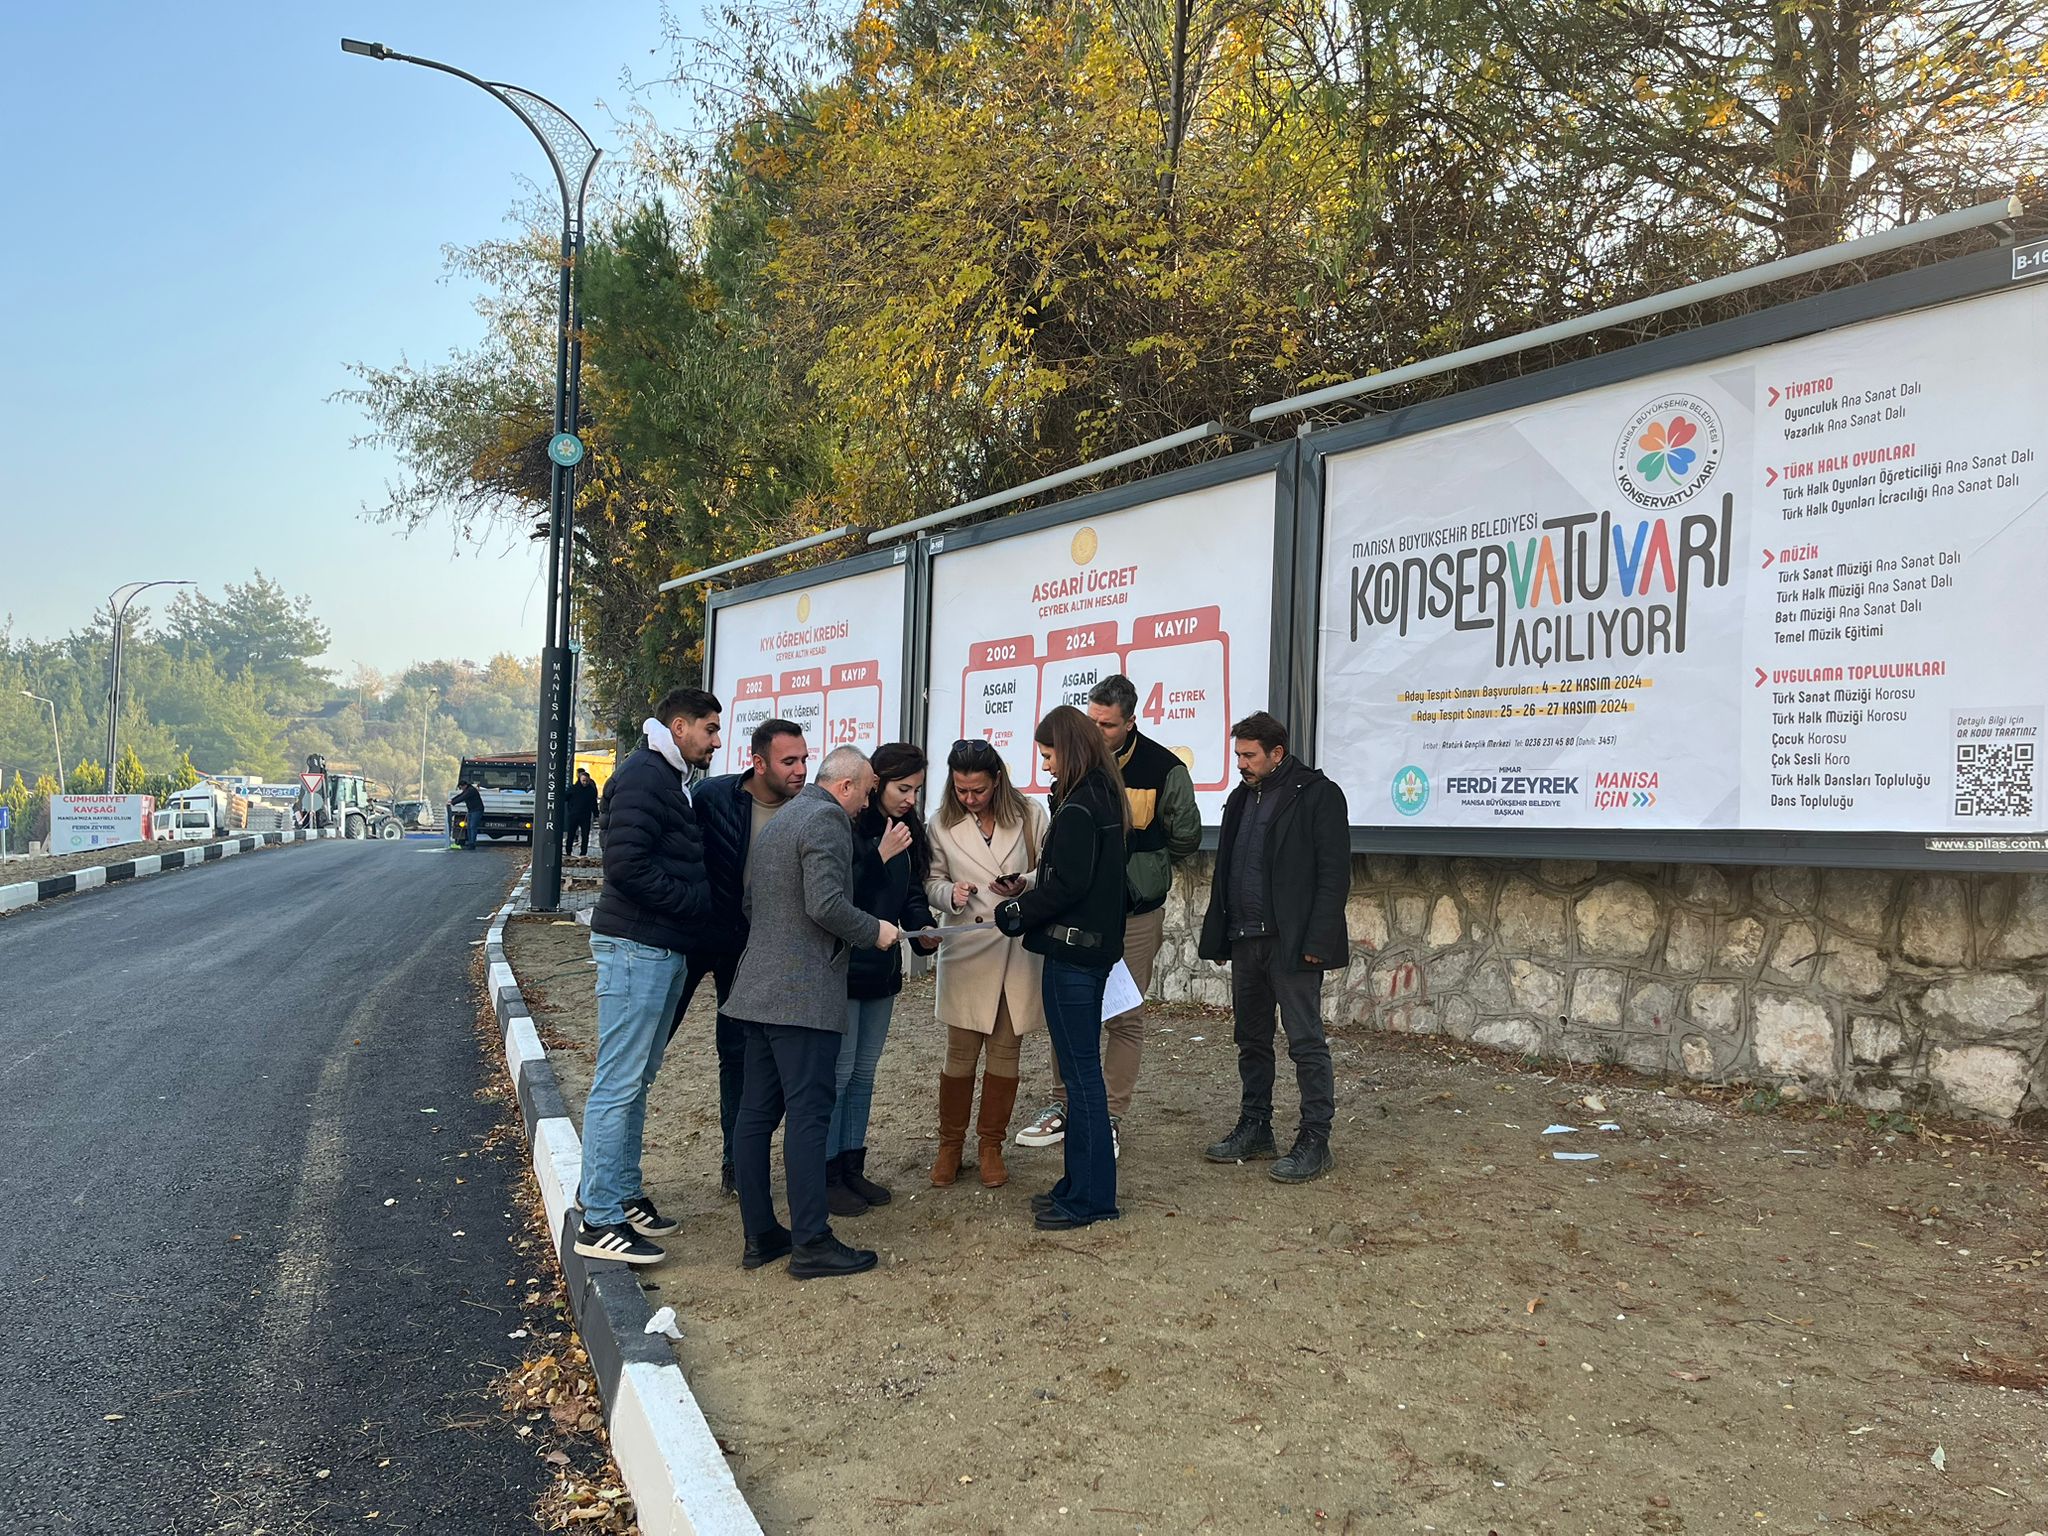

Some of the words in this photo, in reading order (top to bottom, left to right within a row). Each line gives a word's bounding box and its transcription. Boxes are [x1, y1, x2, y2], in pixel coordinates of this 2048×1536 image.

[1785, 377, 1833, 400] TİYATRO
[1784, 398, 1838, 421] Oyunculuk
[1841, 395, 1861, 408] Ana
[1865, 386, 1896, 404] Sanat
[1900, 381, 1921, 396] Dalı
[1620, 425, 1637, 459] MANİSA
[1636, 398, 1688, 425] BÜYÜKŞEHİR
[1689, 402, 1717, 443] BELEDİYESİ
[1784, 422, 1824, 440] Yazarlık
[1828, 419, 1847, 432] Ana
[1851, 410, 1882, 427] Sanat
[1886, 405, 1905, 420] Dalı
[1783, 461, 1813, 480] TÜRK
[1818, 453, 1848, 472] HALK
[1853, 443, 1916, 466] OYUNLARI
[1618, 460, 1716, 507] KONSERVATUVARI
[1783, 486, 1804, 500] Türk
[1807, 481, 1829, 496] Halk
[1833, 474, 1875, 494] Oyunları
[1879, 462, 1941, 485] Öğreticiliği
[1946, 460, 1968, 473] Ana
[1972, 453, 2007, 469] Sanat
[2011, 448, 2034, 464] Dalı
[1782, 507, 1803, 521] Türk
[1806, 502, 1828, 516] Halk
[1831, 496, 1875, 515] Oyunları
[1879, 486, 1927, 505] İcracılığı
[1932, 483, 1953, 497] Ana
[1958, 478, 1992, 493] Sanat
[1997, 474, 2019, 488] Dalı
[1780, 543, 1818, 564] MÜZİK
[1778, 570, 1800, 583] Türk
[1803, 567, 1833, 580] Sanat
[1837, 561, 1872, 579] Müziği
[1876, 559, 1897, 572] Ana
[1901, 554, 1934, 569] Sanat
[1939, 551, 1960, 565] Dalı
[1032, 571, 1084, 603] ASGARİ
[1087, 566, 1138, 593] ÜCRET
[1350, 492, 1733, 668] KONSERVATUVARI
[1777, 591, 1798, 603] Türk
[1802, 588, 1825, 601] Halk
[1828, 583, 1864, 600] Müziği
[1868, 581, 1889, 594] Ana
[1893, 577, 1926, 591] Sanat
[1931, 574, 1952, 588] Dalı
[1039, 602, 1069, 619] ÇEYREK
[1070, 598, 1093, 611] ALTIN
[1095, 593, 1128, 607] HESABI
[1775, 612, 1797, 623] Batı
[1800, 606, 1835, 624] Müziği
[1839, 605, 1860, 618] Ana
[1864, 601, 1896, 616] Sanat
[1900, 599, 1922, 613] Dalı
[760, 636, 774, 652] KYK
[777, 626, 812, 649] ÖĞRENCİ
[813, 619, 849, 642] KREDİSİ
[1154, 617, 1198, 638] KAYIP
[1509, 604, 1671, 668] AÇILIYOR
[1774, 631, 1805, 644] Temel
[1808, 627, 1841, 642] Müzik
[1845, 624, 1883, 642] Eğitimi
[1066, 633, 1095, 650] 2024
[986, 644, 1016, 662] 2002
[792, 674, 810, 688] 2024
[841, 667, 866, 682] KAYIP
[1062, 668, 1097, 688] ASGARİ
[1773, 667, 1843, 684] UYGULAMA
[1848, 660, 1946, 680] TOPLULUKLARI
[551, 662, 560, 721] MANİSA
[746, 681, 762, 694] 2002
[983, 679, 1016, 697] ASGARİ
[1169, 689, 1205, 704] ÇEYREK
[1405, 689, 1424, 703] Aday
[1427, 687, 1451, 702] Tespit
[1454, 686, 1480, 699] Sınavı
[1482, 684, 1533, 699] Başvuruları
[1542, 681, 1548, 693] 4
[1561, 680, 1572, 692] 22
[1576, 677, 1610, 691] KASIM
[1615, 675, 1642, 689] 2024
[1773, 692, 1794, 704] Türk
[1798, 691, 1830, 703] Sanat
[1834, 688, 1871, 704] Müziği
[1876, 689, 1915, 700] Korosu
[985, 698, 1013, 715] ÜCRET
[1062, 692, 1088, 706] ÜCRE
[1142, 682, 1165, 725] 4
[782, 708, 793, 718] KYK
[794, 703, 819, 718] ÖĞRENCİ
[1167, 708, 1195, 720] ALTIN
[1417, 710, 1436, 723] Aday
[1439, 708, 1463, 722] Tespit
[1467, 707, 1492, 719] Sınavı
[1501, 705, 1512, 717] 25
[1524, 704, 1535, 716] 26
[1548, 703, 1558, 715] 27
[1563, 700, 1596, 714] KASIM
[1600, 699, 1627, 713] 2024
[1772, 713, 1794, 724] Türk
[1798, 711, 1822, 724] Halk
[1826, 710, 1863, 725] Müziği
[1867, 710, 1907, 722] Korosu
[829, 718, 857, 747] 1,25
[1555, 738, 1563, 746] 45
[1771, 732, 1804, 747] Çocuk
[1808, 732, 1846, 744] Korosu
[1970, 729, 1992, 737] KODU
[1995, 727, 2037, 736] TARATINIZ
[1771, 753, 1791, 767] Çok
[1794, 753, 1820, 765] Sesli
[1825, 753, 1850, 765] Koro
[1447, 777, 1496, 794] FERDİ
[1501, 776, 1579, 794] ZEYREK
[1595, 772, 1658, 788] MANİSA
[1771, 774, 1793, 786] Türk
[1797, 774, 1820, 786] Halk
[1824, 774, 1871, 786] Dansları
[1875, 774, 1931, 789] Topluluğu
[1771, 795, 1796, 807] Dans
[1800, 794, 1853, 810] Topluluğu
